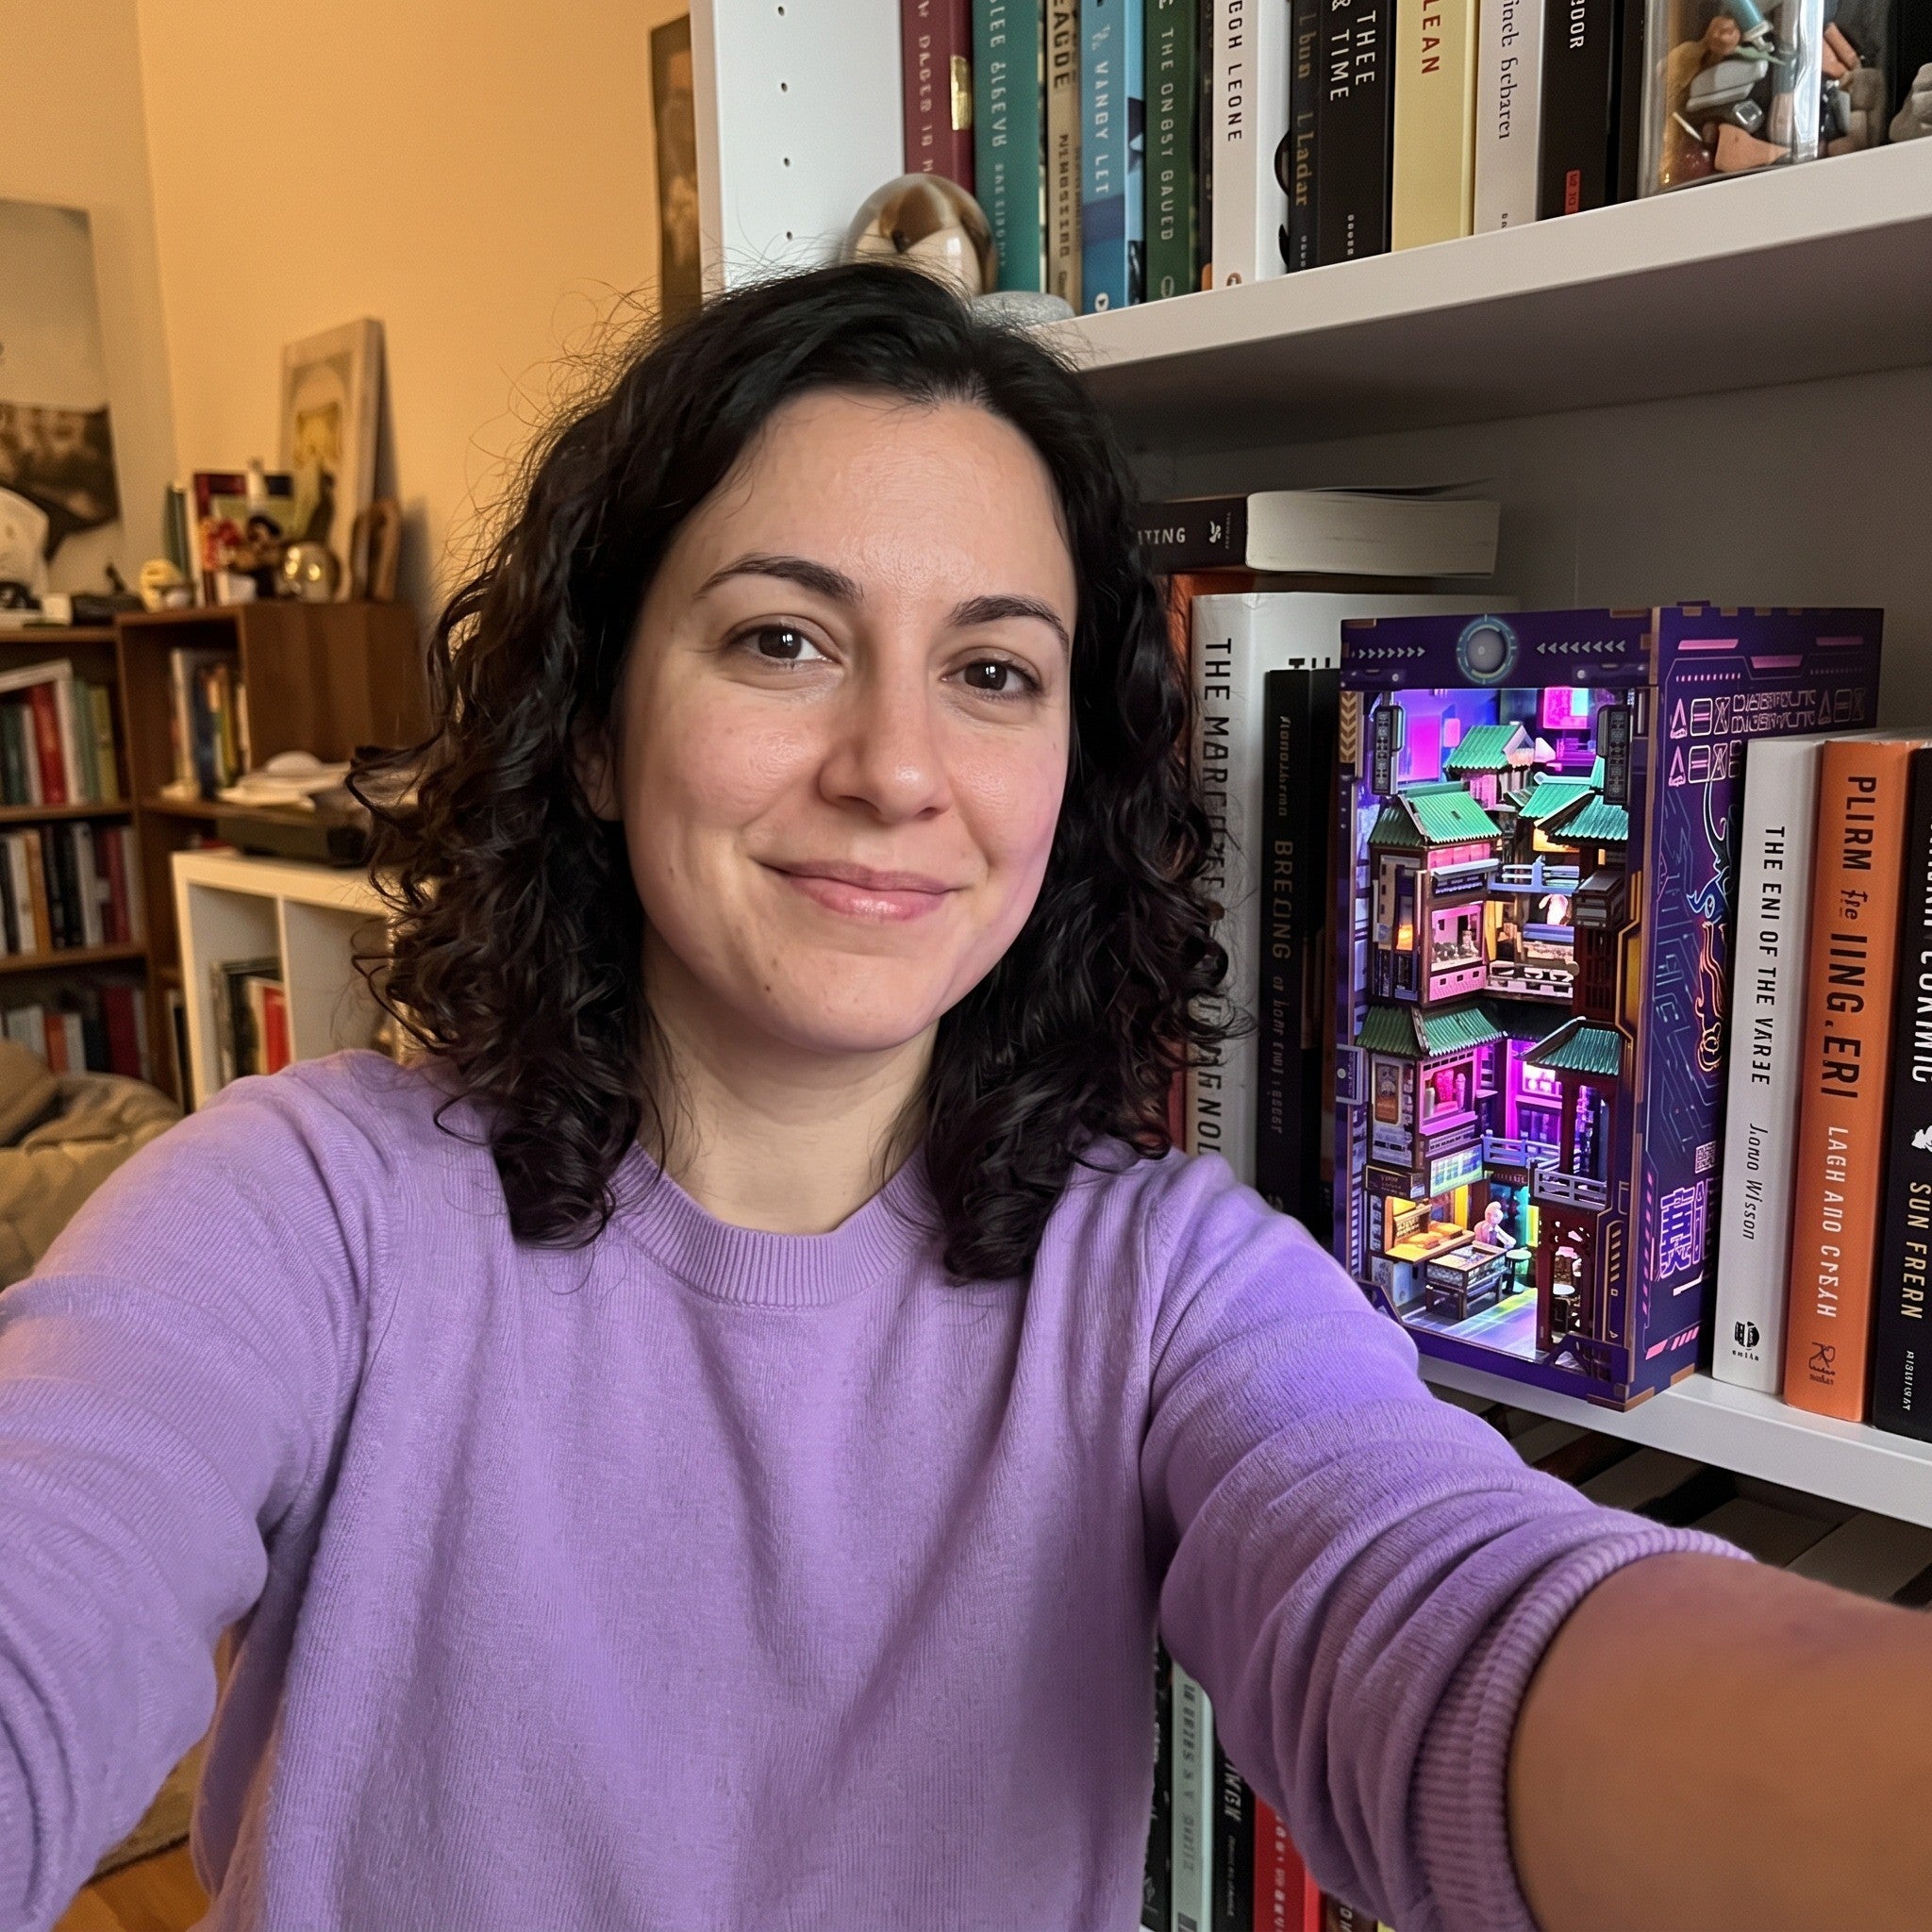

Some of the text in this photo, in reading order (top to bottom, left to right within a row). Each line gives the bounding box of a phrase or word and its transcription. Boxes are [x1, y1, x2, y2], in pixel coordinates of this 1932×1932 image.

[1160, 27, 1174, 71] THE
[1329, 28, 1350, 102] TIME
[1355, 9, 1376, 86] THEE
[1227, 63, 1242, 142] LEONE
[1203, 638, 1231, 700] THE
[1763, 825, 1786, 871] THE
[1841, 776, 1877, 871] PLIRM
[1760, 882, 1782, 920] ENI
[1758, 930, 1779, 958] OF
[1756, 967, 1777, 1006] THE
[1907, 1181, 1932, 1229] SUN
[1900, 1241, 1927, 1319] FRERN
